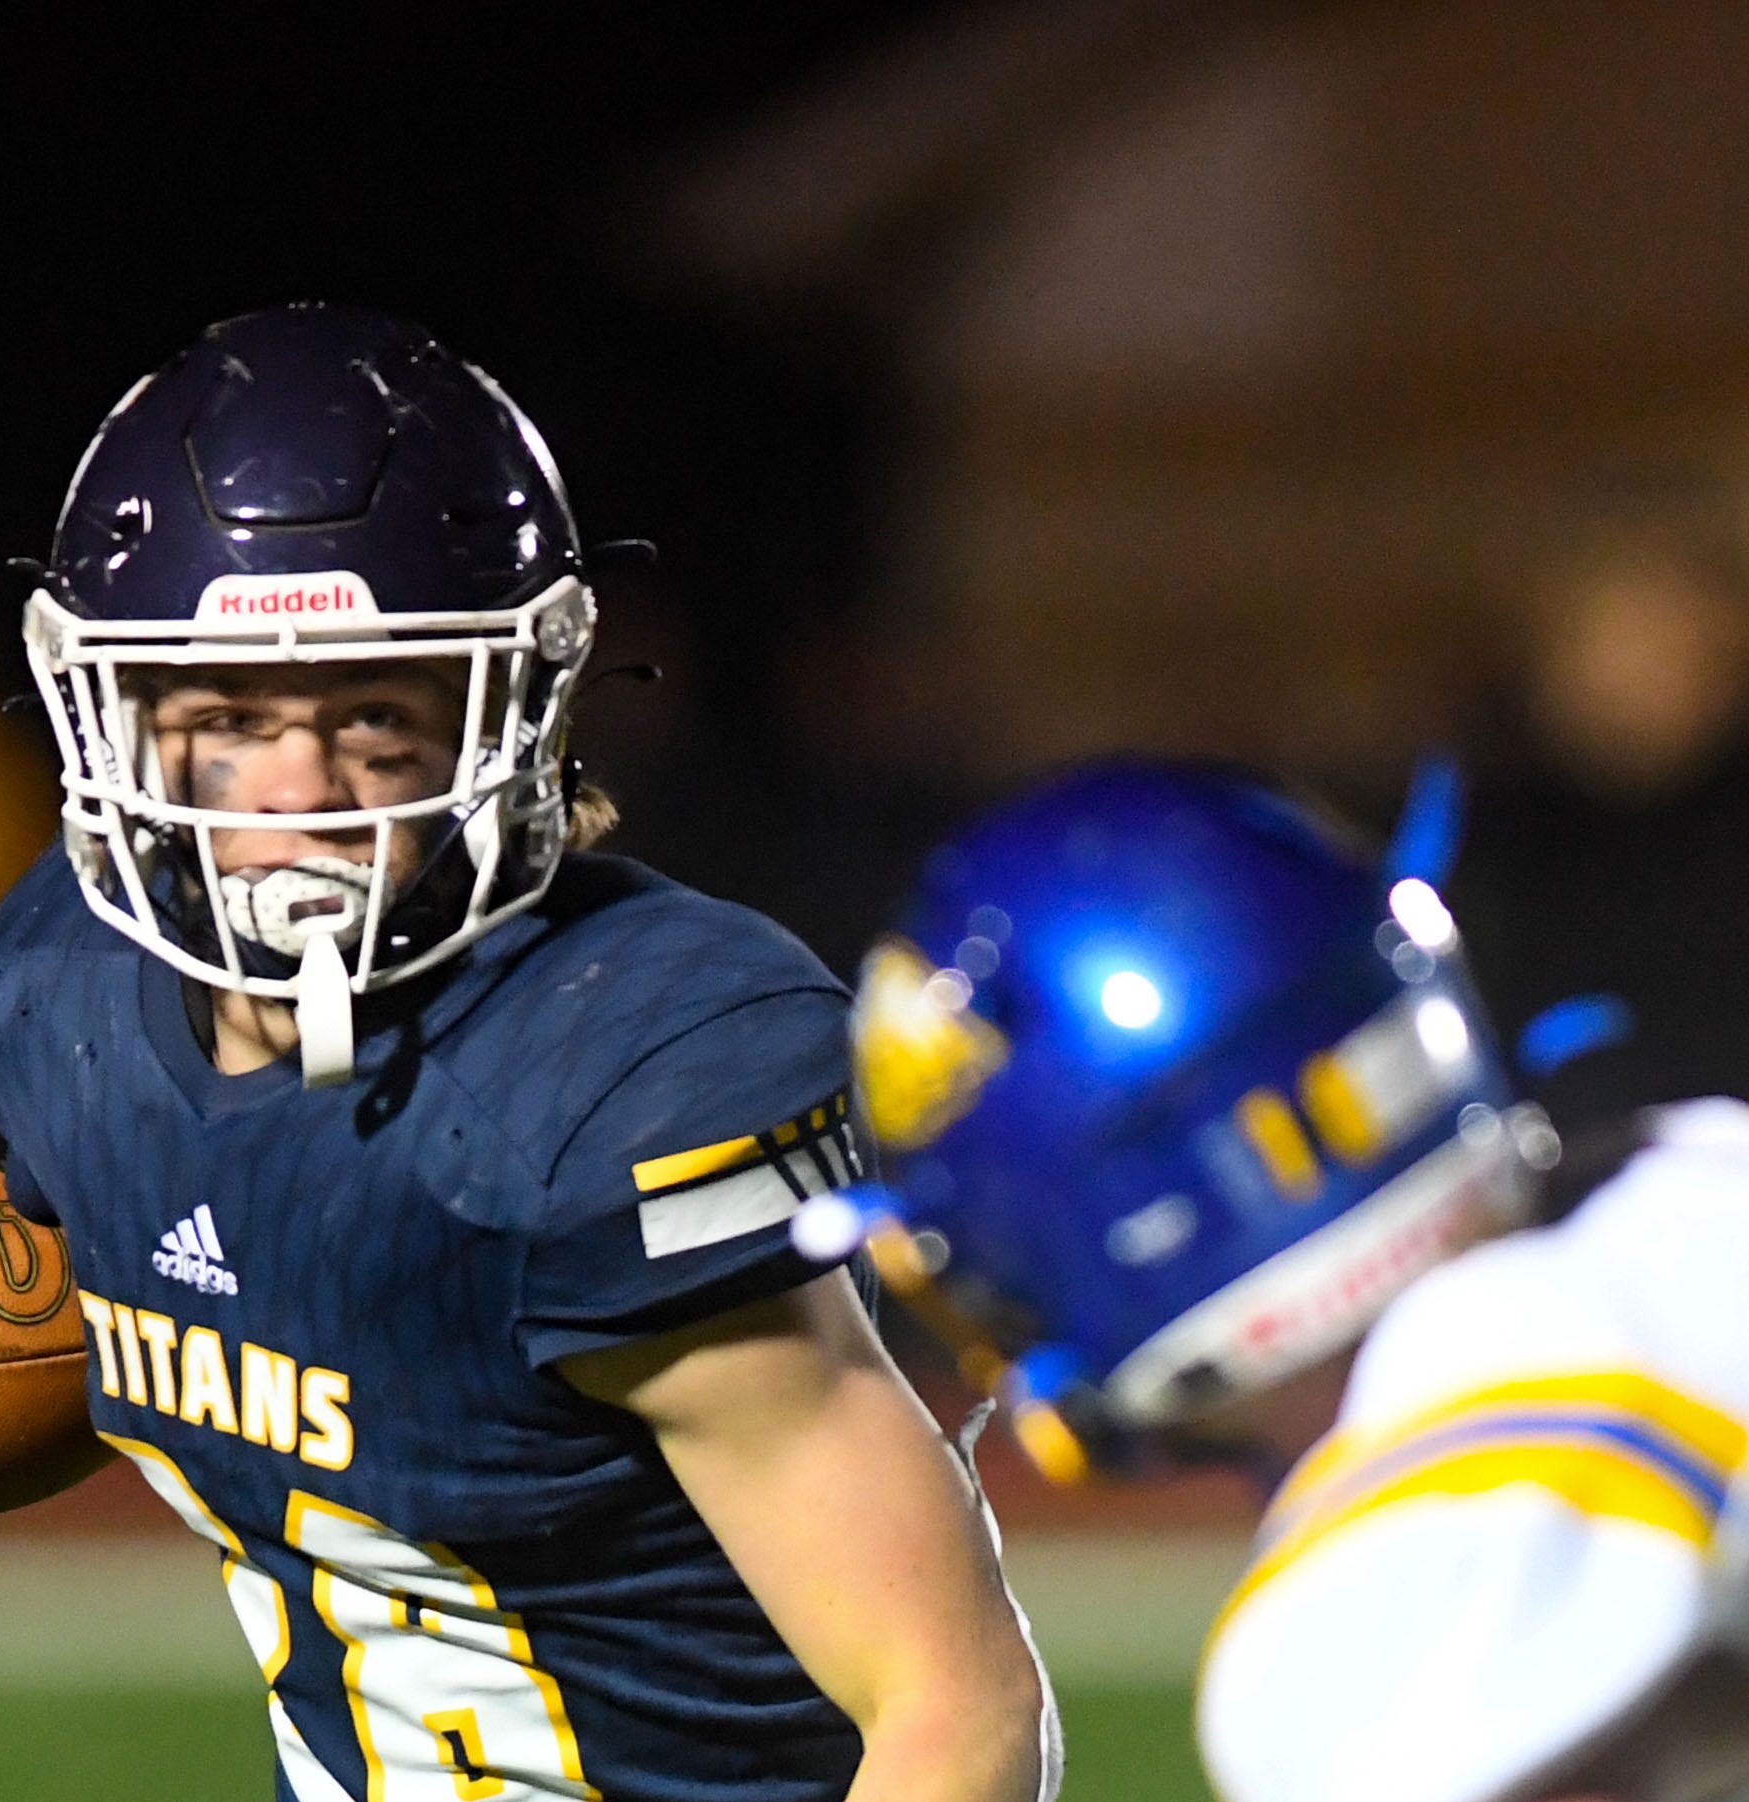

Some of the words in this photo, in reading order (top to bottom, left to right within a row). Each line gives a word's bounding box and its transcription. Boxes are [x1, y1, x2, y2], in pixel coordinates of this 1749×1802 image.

[219, 584, 355, 614] Riddell
[151, 1247, 239, 1296] adidas
[77, 1288, 355, 1472] TITANS
